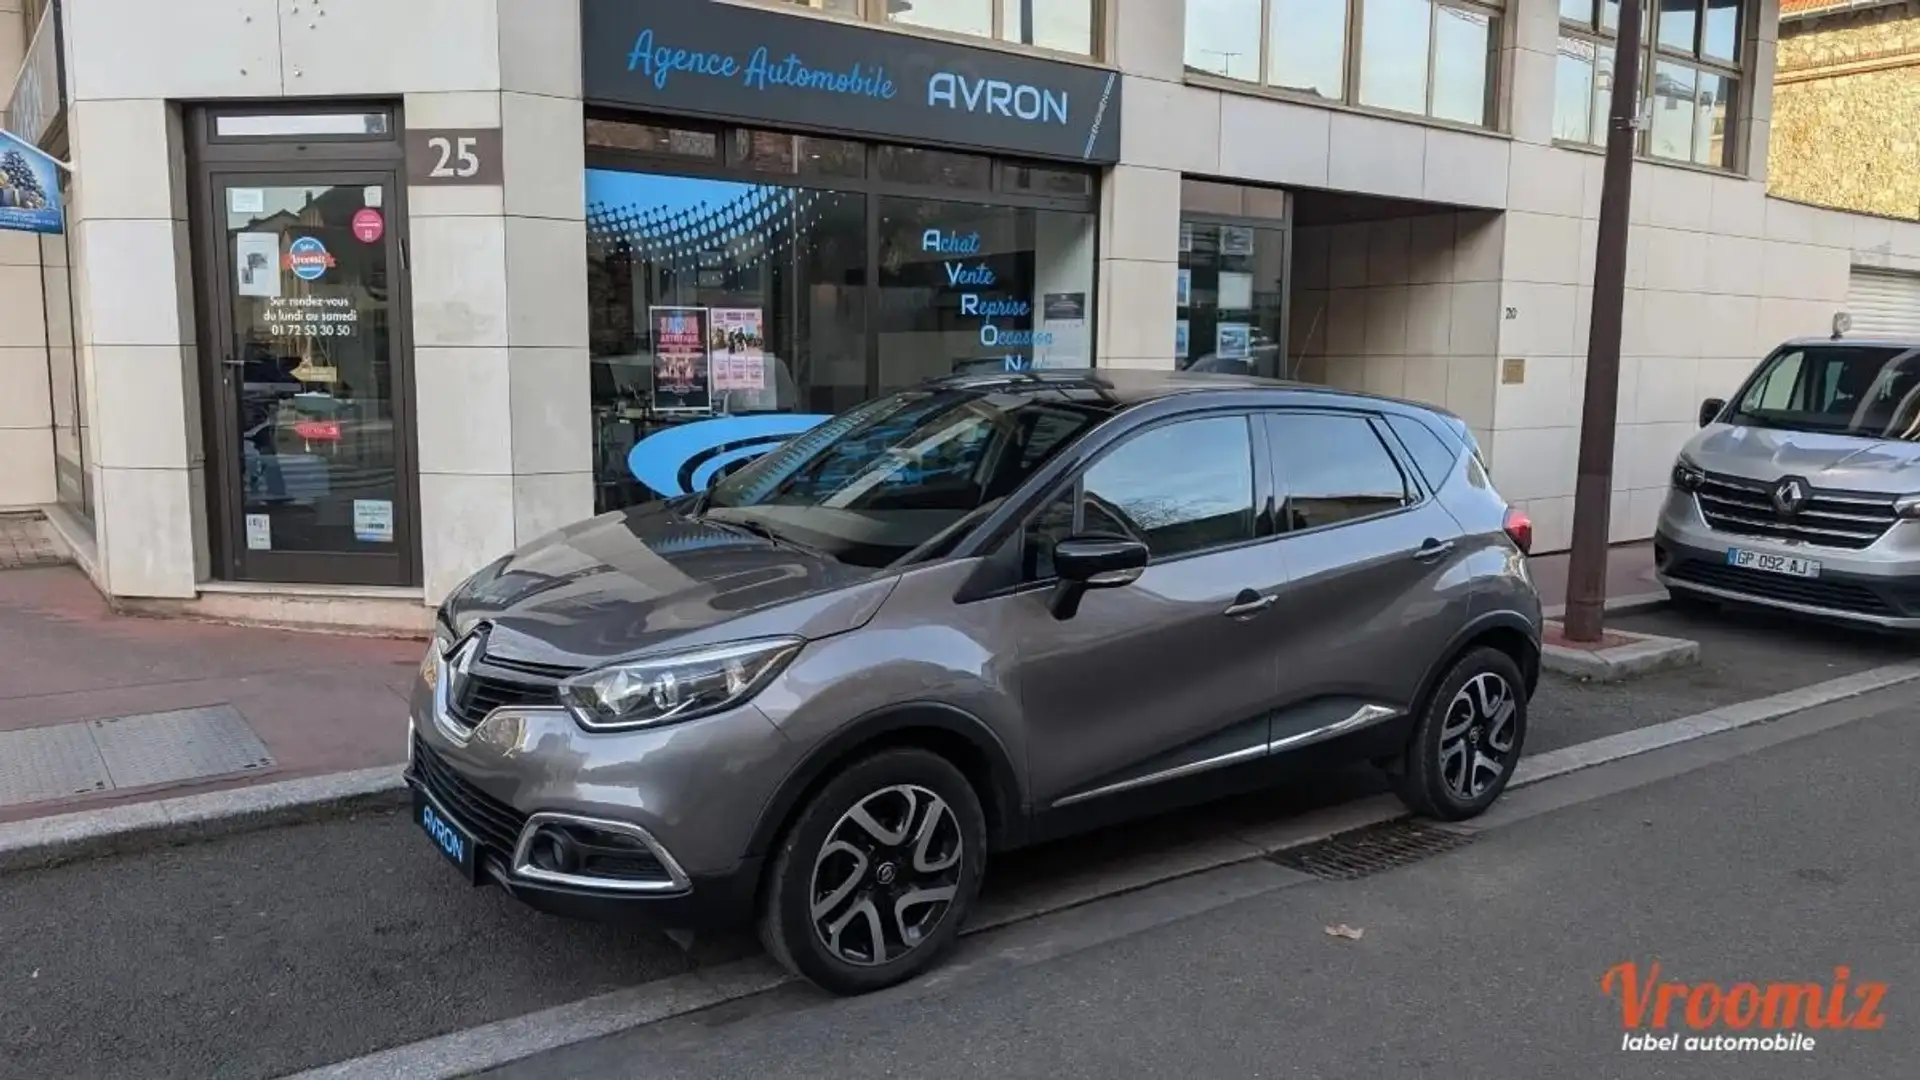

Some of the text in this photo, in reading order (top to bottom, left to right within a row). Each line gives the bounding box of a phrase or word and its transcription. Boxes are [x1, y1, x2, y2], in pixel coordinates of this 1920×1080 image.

[628, 29, 1068, 125] Agence Automobile AVRON
[428, 137, 480, 177] 25
[922, 229, 980, 253] Achat
[944, 262, 996, 287] Vente
[270, 295, 349, 307] Sur rendez-vous
[961, 293, 1030, 324] Reprise
[263, 309, 358, 321] du lundi au samedi
[271, 325, 350, 336] 01 72 53 30 50
[980, 325, 1053, 346] Occasion
[1737, 551, 1808, 574] GP 092 AJ
[424, 805, 464, 864] AVRON
